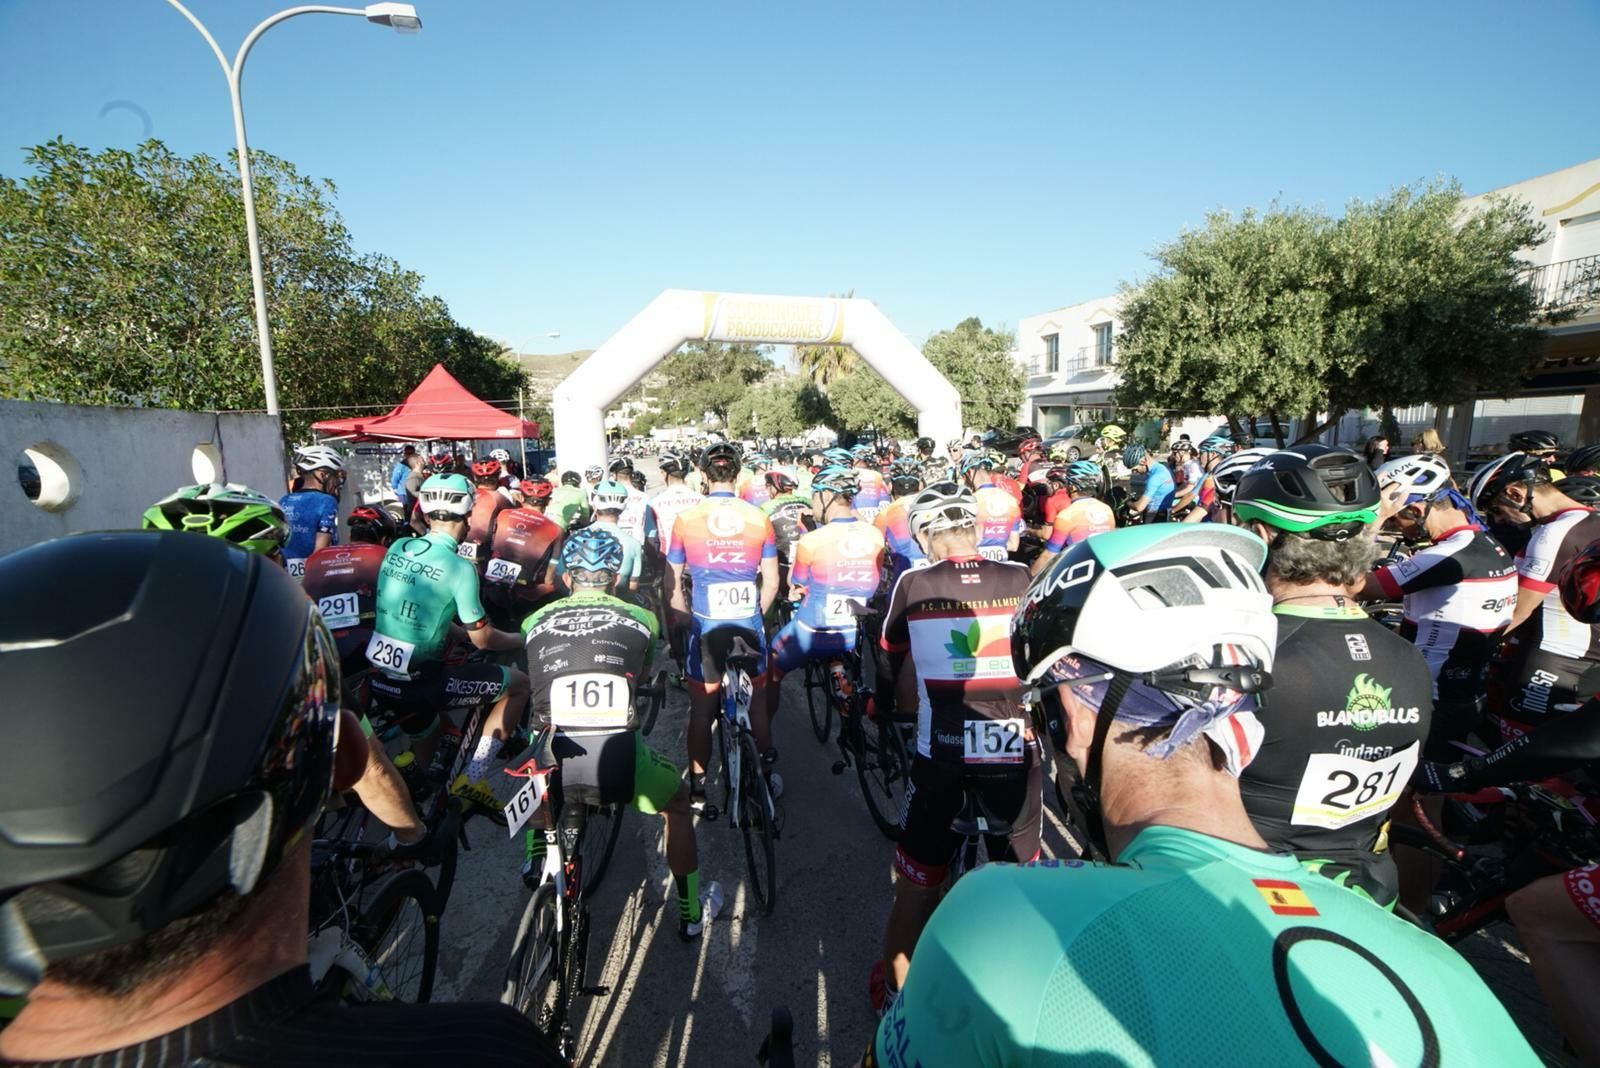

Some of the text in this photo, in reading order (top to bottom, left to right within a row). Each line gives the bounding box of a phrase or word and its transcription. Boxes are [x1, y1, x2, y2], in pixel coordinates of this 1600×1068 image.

[728, 320, 824, 338] PRODUCCIONES
[985, 525, 1007, 535] KZ
[706, 538, 745, 547] Chaves
[708, 552, 746, 563] KZ
[837, 559, 873, 567] Chaves
[982, 549, 1004, 562] 206
[290, 562, 306, 577] 26
[837, 571, 873, 582] KZ
[718, 587, 751, 606] 204
[941, 601, 952, 611] LA
[956, 599, 989, 610] PESETA
[320, 595, 356, 618] 291
[530, 615, 642, 638] AVENTURA
[568, 622, 593, 631] BIKE
[372, 640, 404, 668] 236
[445, 677, 502, 696] BIKESTORE
[565, 680, 616, 708] 161
[963, 722, 1022, 754] 152
[1320, 761, 1402, 810] 281
[508, 781, 538, 823] 161
